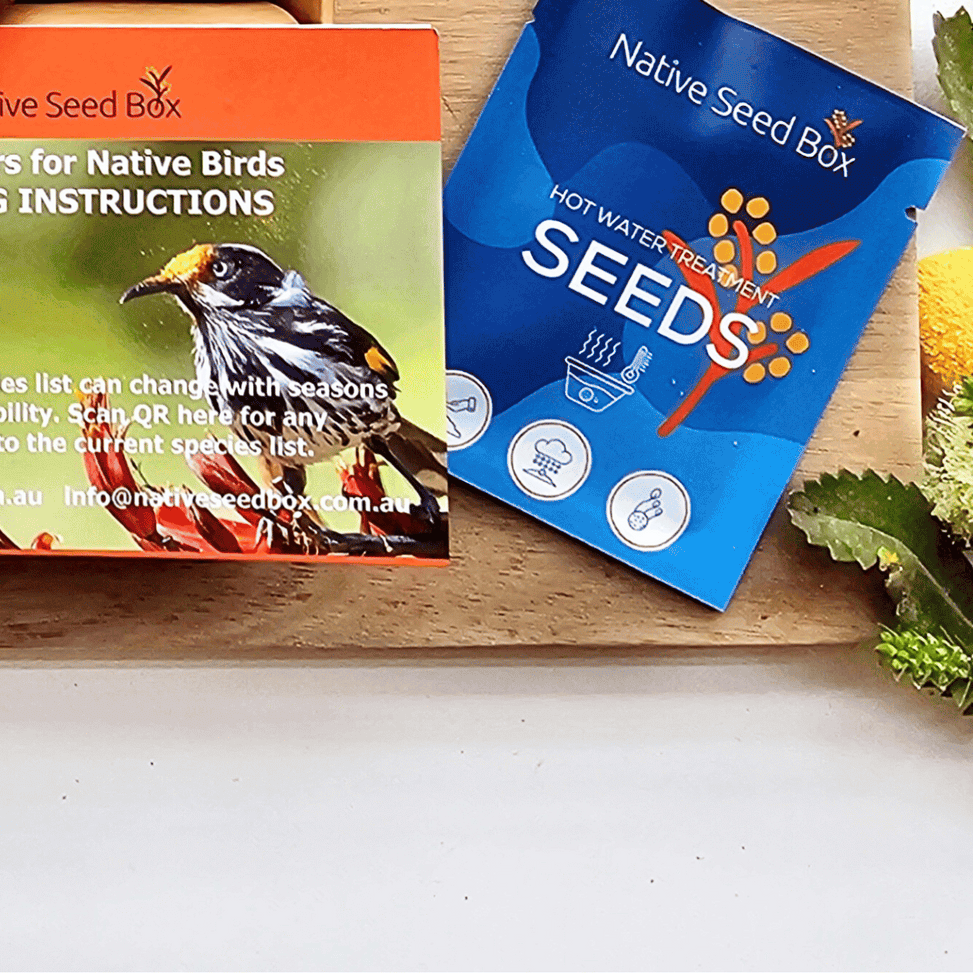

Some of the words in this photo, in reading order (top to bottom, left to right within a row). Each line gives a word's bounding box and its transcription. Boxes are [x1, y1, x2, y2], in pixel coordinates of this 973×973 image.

[45, 90, 117, 119] Seed
[127, 92, 182, 119] Box
[610, 33, 707, 104] Native
[711, 87, 796, 145] Seed
[795, 127, 856, 178] Box
[31, 148, 77, 176] for
[88, 149, 192, 177] Native
[202, 149, 285, 179] Birds
[18, 188, 275, 216] INSTRUCTIONS
[549, 184, 597, 216] HOT
[597, 206, 669, 254] WATER
[669, 242, 780, 309] TREATMENT
[521, 219, 759, 369] SEEDS
[35, 373, 73, 394] list
[79, 376, 122, 394] can
[129, 374, 219, 400] change
[227, 376, 280, 397] with
[288, 381, 389, 399] seasons
[67, 402, 126, 425] Scan
[133, 404, 170, 429] QR
[178, 405, 234, 426] here
[240, 405, 277, 427] for
[283, 411, 328, 433] any
[27, 432, 68, 453] the
[73, 434, 165, 455] current
[171, 437, 263, 460] species
[269, 436, 315, 458] list.
